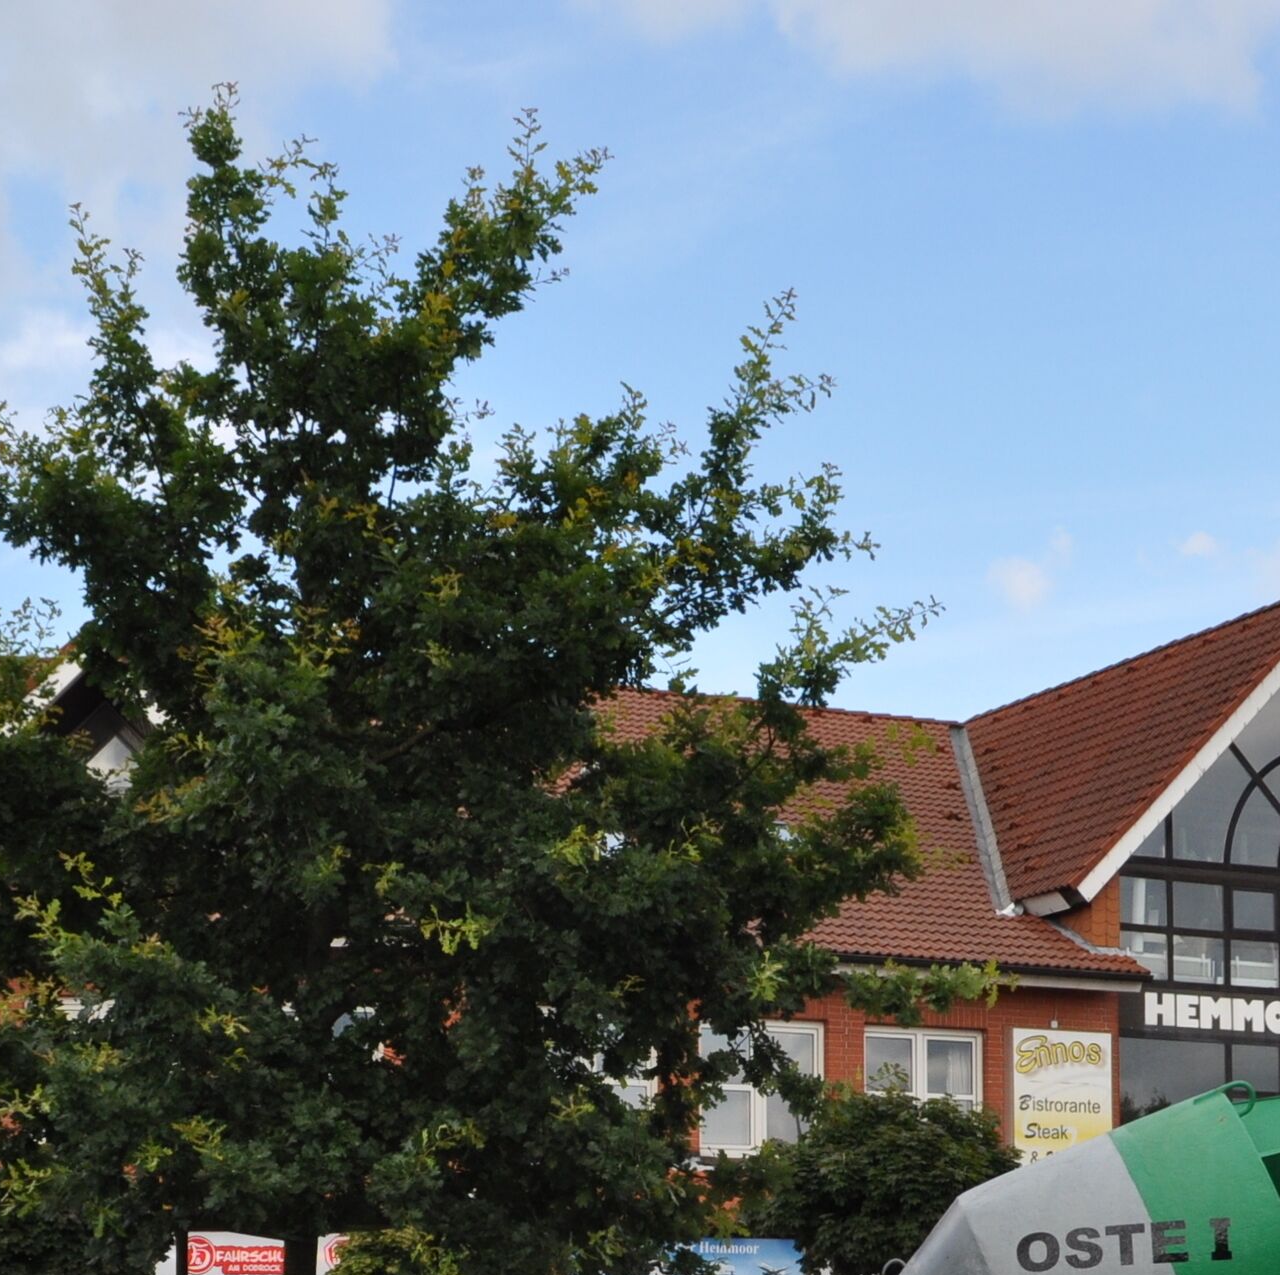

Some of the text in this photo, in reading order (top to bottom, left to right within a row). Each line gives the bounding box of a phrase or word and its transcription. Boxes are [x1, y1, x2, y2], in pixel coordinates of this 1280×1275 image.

[1015, 1034, 1103, 1074] Ennos
[1019, 1094, 1101, 1114] Bistrorante
[1024, 1122, 1069, 1140] Steak
[1016, 1219, 1189, 1272] OSTE
[216, 1250, 284, 1263] FAHRSCHU
